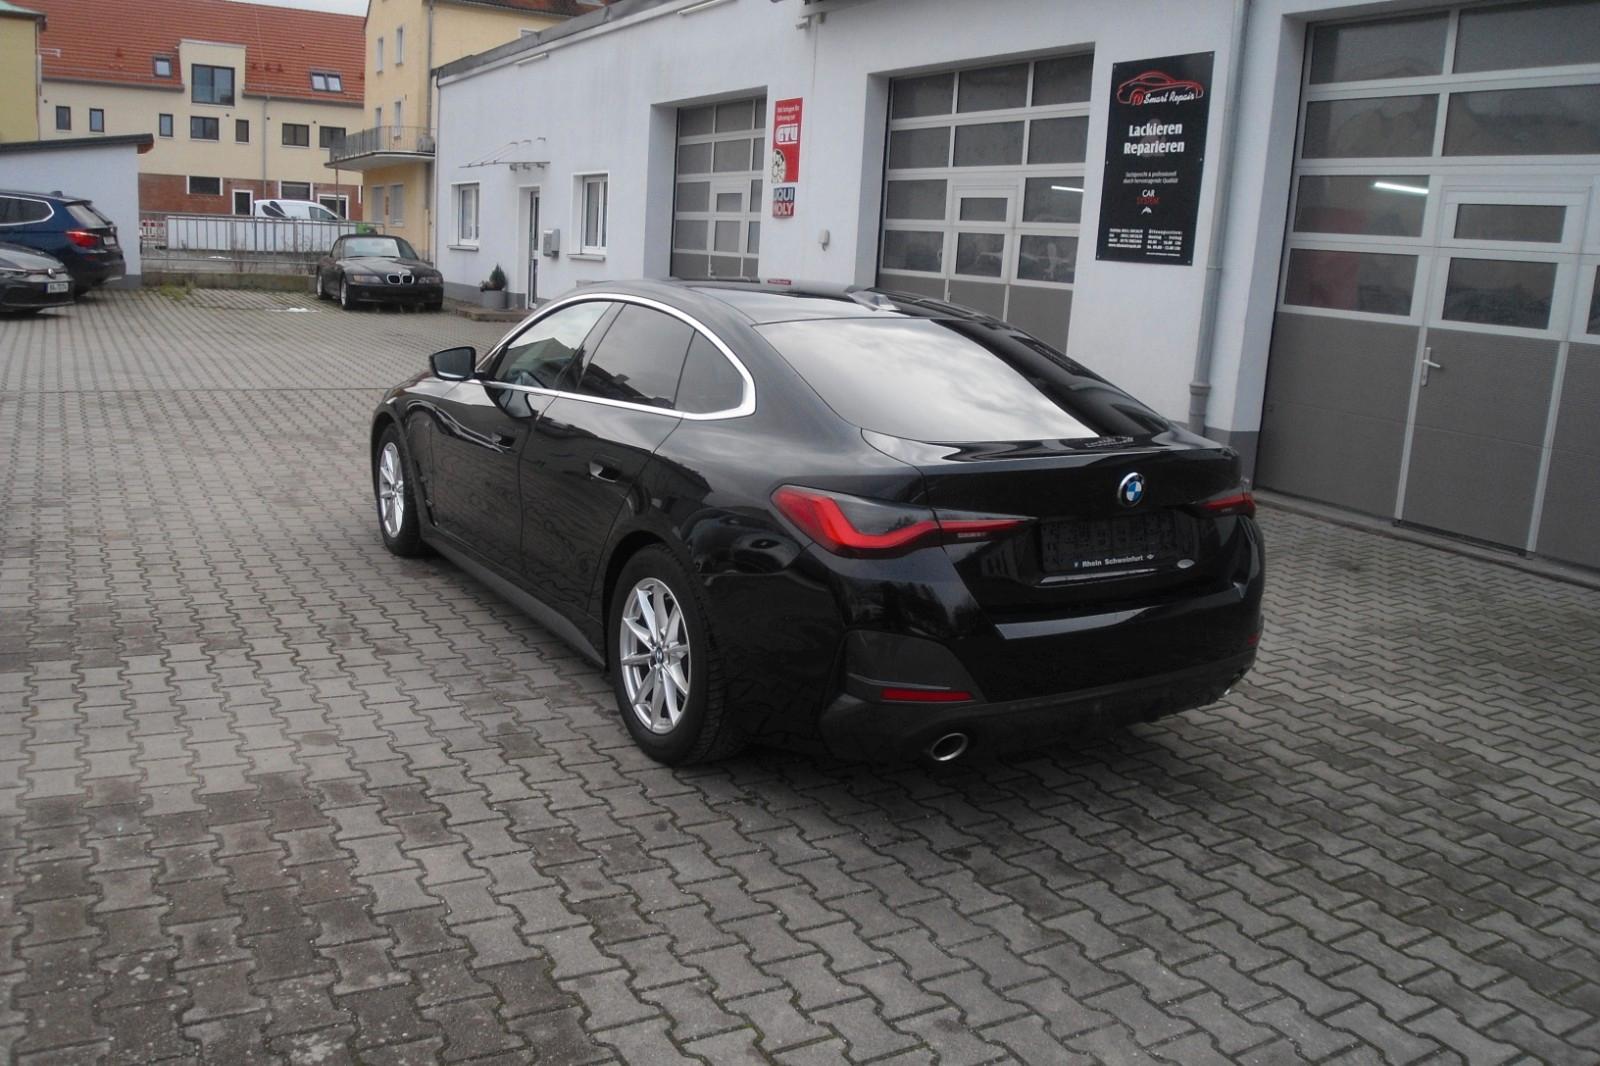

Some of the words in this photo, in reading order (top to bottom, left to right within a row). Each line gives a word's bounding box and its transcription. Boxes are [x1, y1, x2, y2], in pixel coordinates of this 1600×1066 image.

[1143, 92, 1169, 104] Smart
[1169, 90, 1195, 105] Repair
[1128, 122, 1183, 137] Lackieren
[1123, 140, 1185, 156] Reparieren
[1142, 189, 1155, 198] CAR
